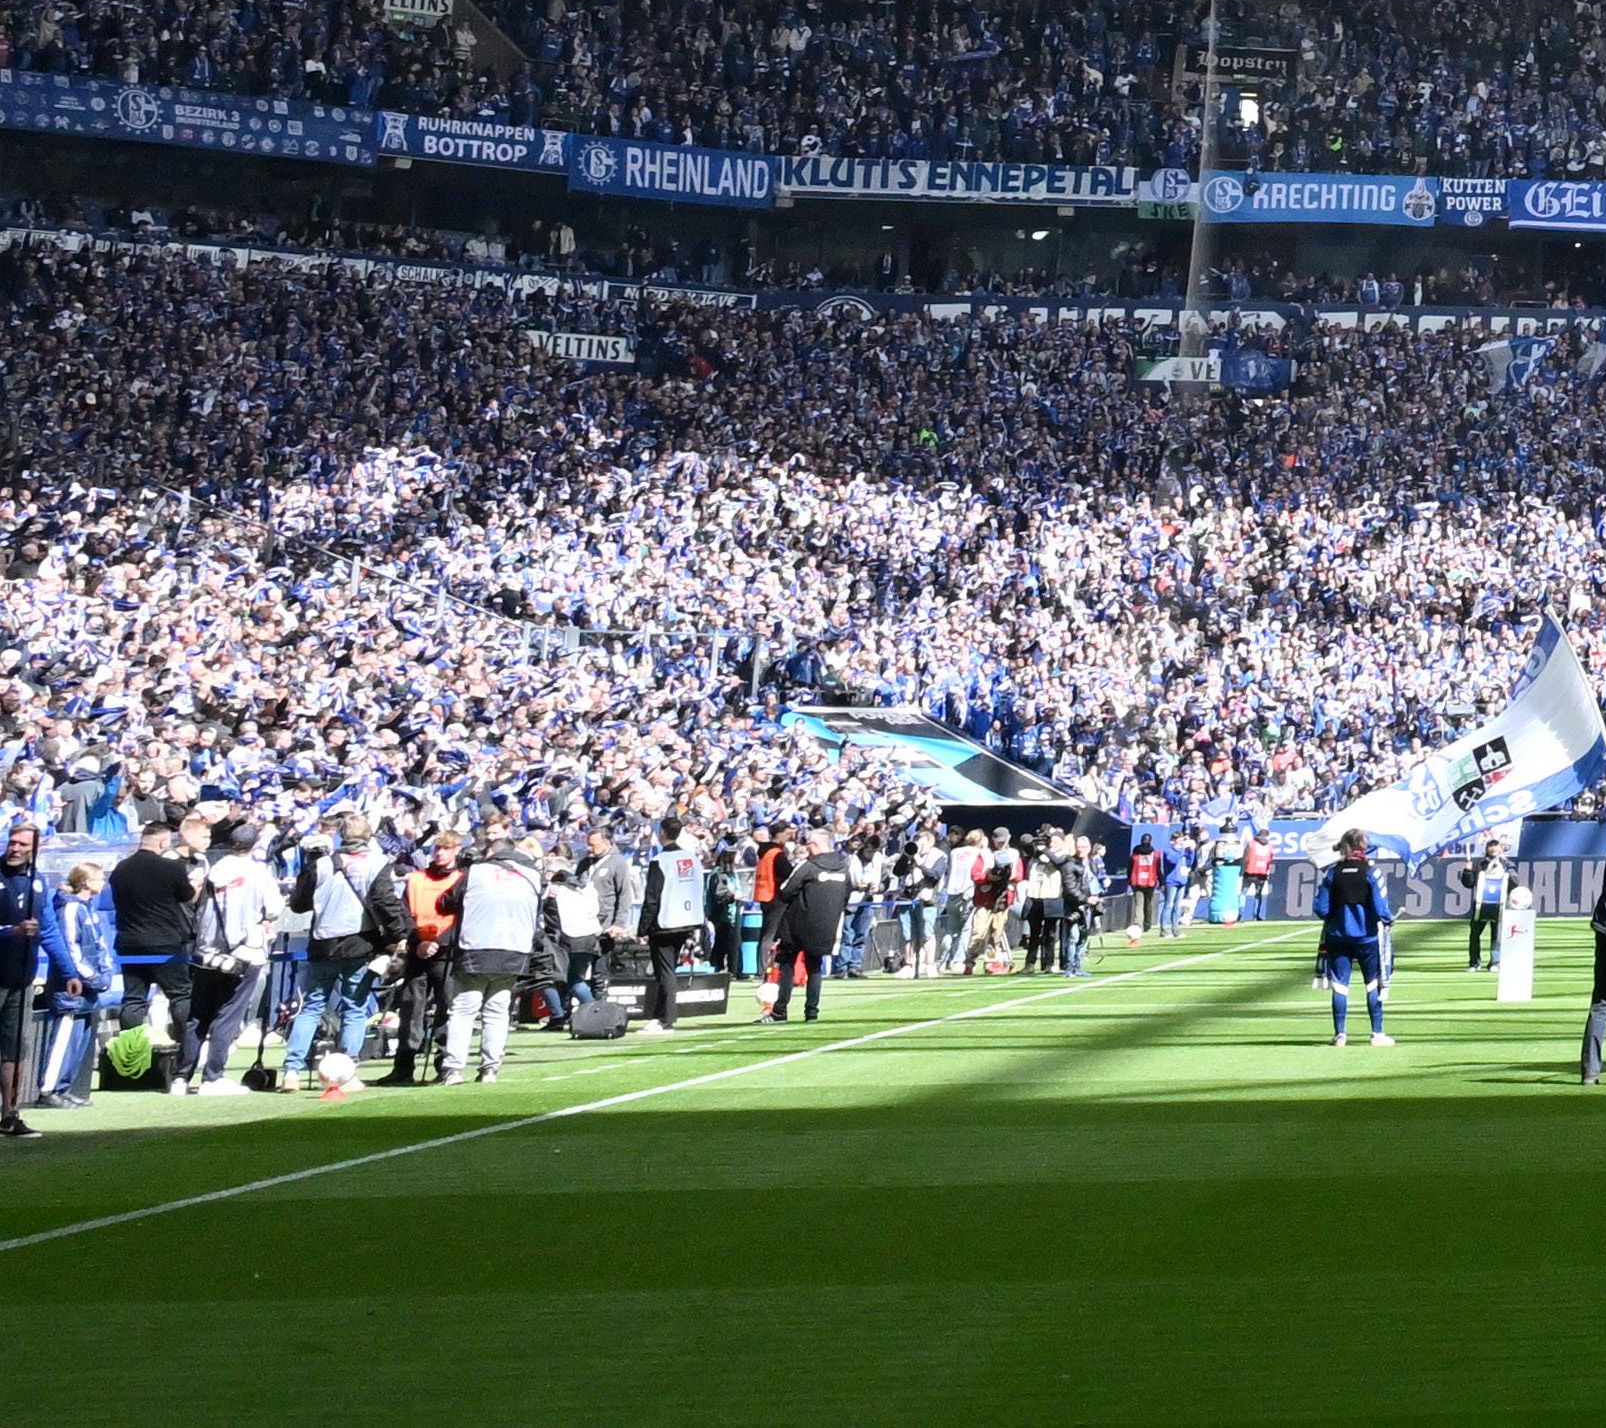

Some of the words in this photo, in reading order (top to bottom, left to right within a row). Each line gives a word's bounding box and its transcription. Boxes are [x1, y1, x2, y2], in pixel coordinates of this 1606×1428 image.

[175, 104, 228, 122] BEZIRK
[229, 110, 241, 123] 3
[418, 117, 536, 143] RUHRKNAPPEN
[423, 137, 529, 164] BOTTROP
[625, 146, 770, 200] RHEINLAND
[927, 161, 1137, 196] ENNEPETAL
[1442, 178, 1506, 194] KUTTEN
[1253, 182, 1397, 211] KRECHTING
[1446, 196, 1502, 212] POWER
[538, 334, 621, 360] VELTINS
